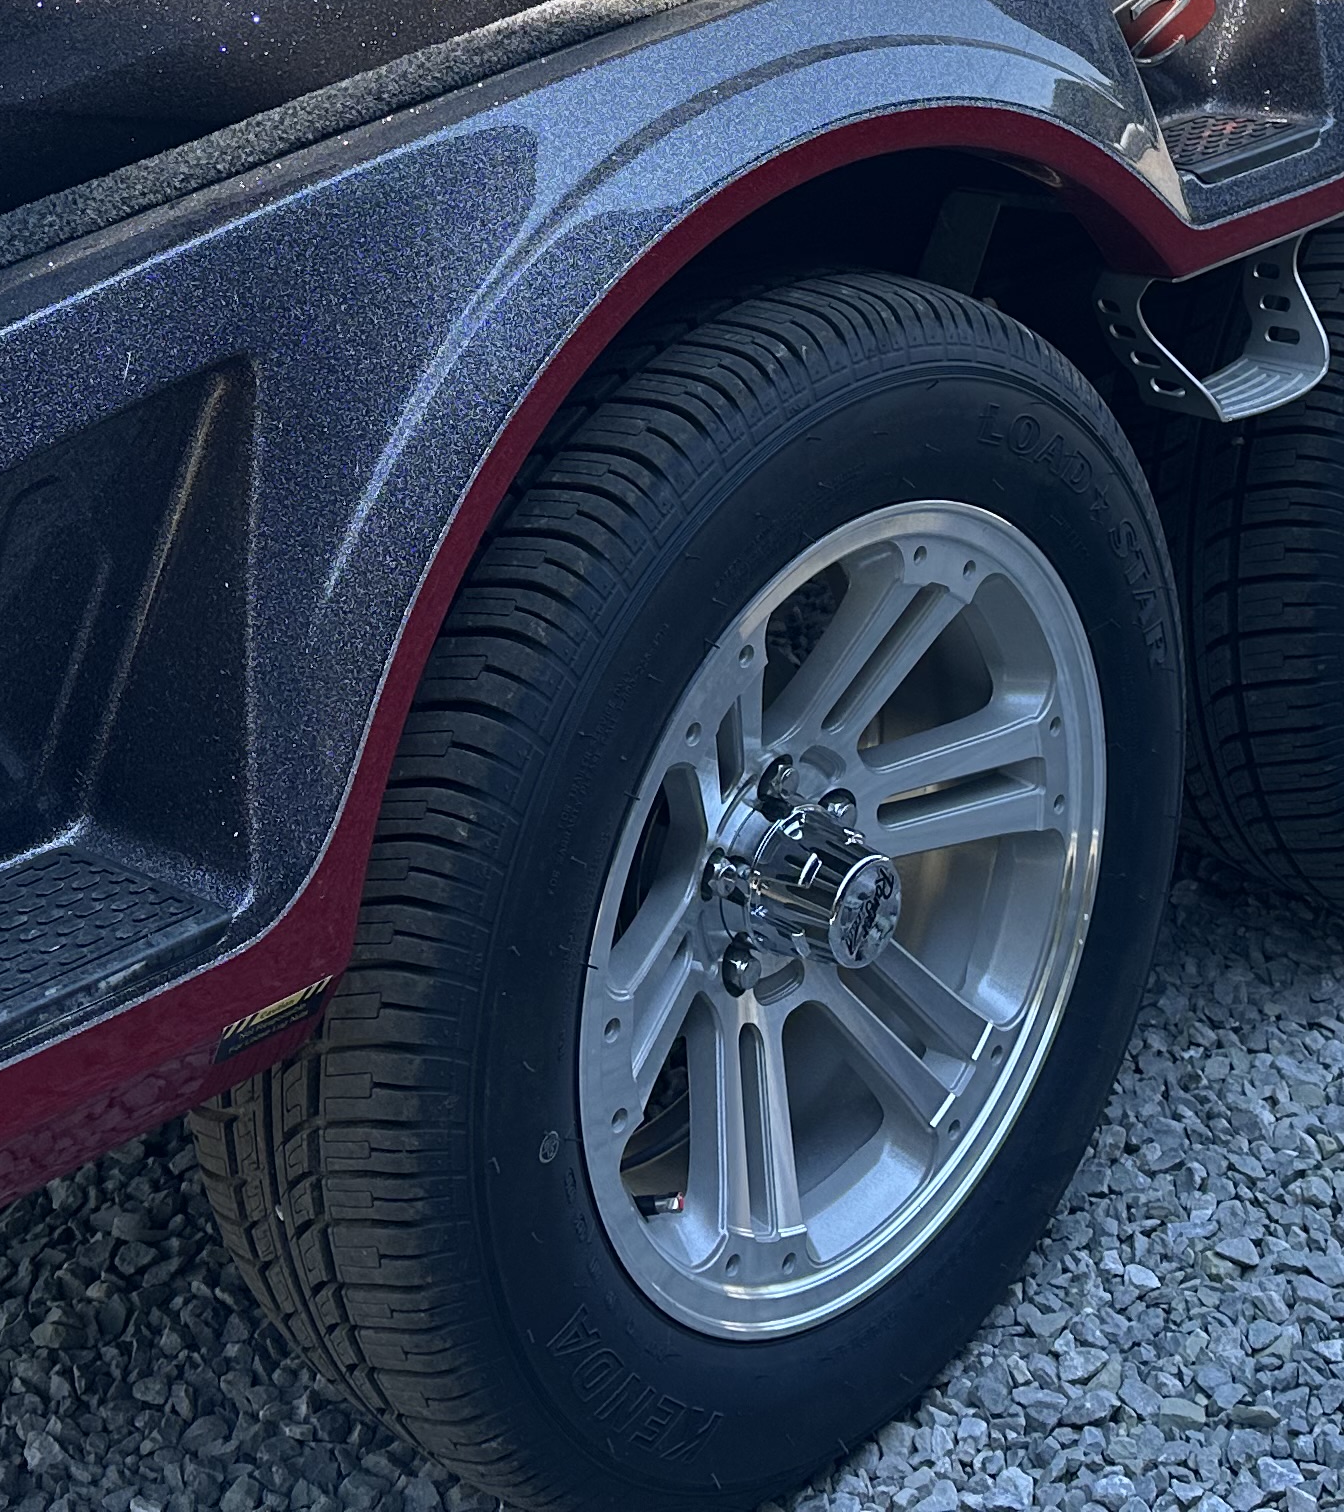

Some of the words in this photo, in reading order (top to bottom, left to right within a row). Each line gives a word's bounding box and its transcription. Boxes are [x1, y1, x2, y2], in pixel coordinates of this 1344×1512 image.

[978, 402, 1092, 494] LOAD
[1108, 519, 1168, 676] STAR
[546, 1303, 724, 1464] KENDA
